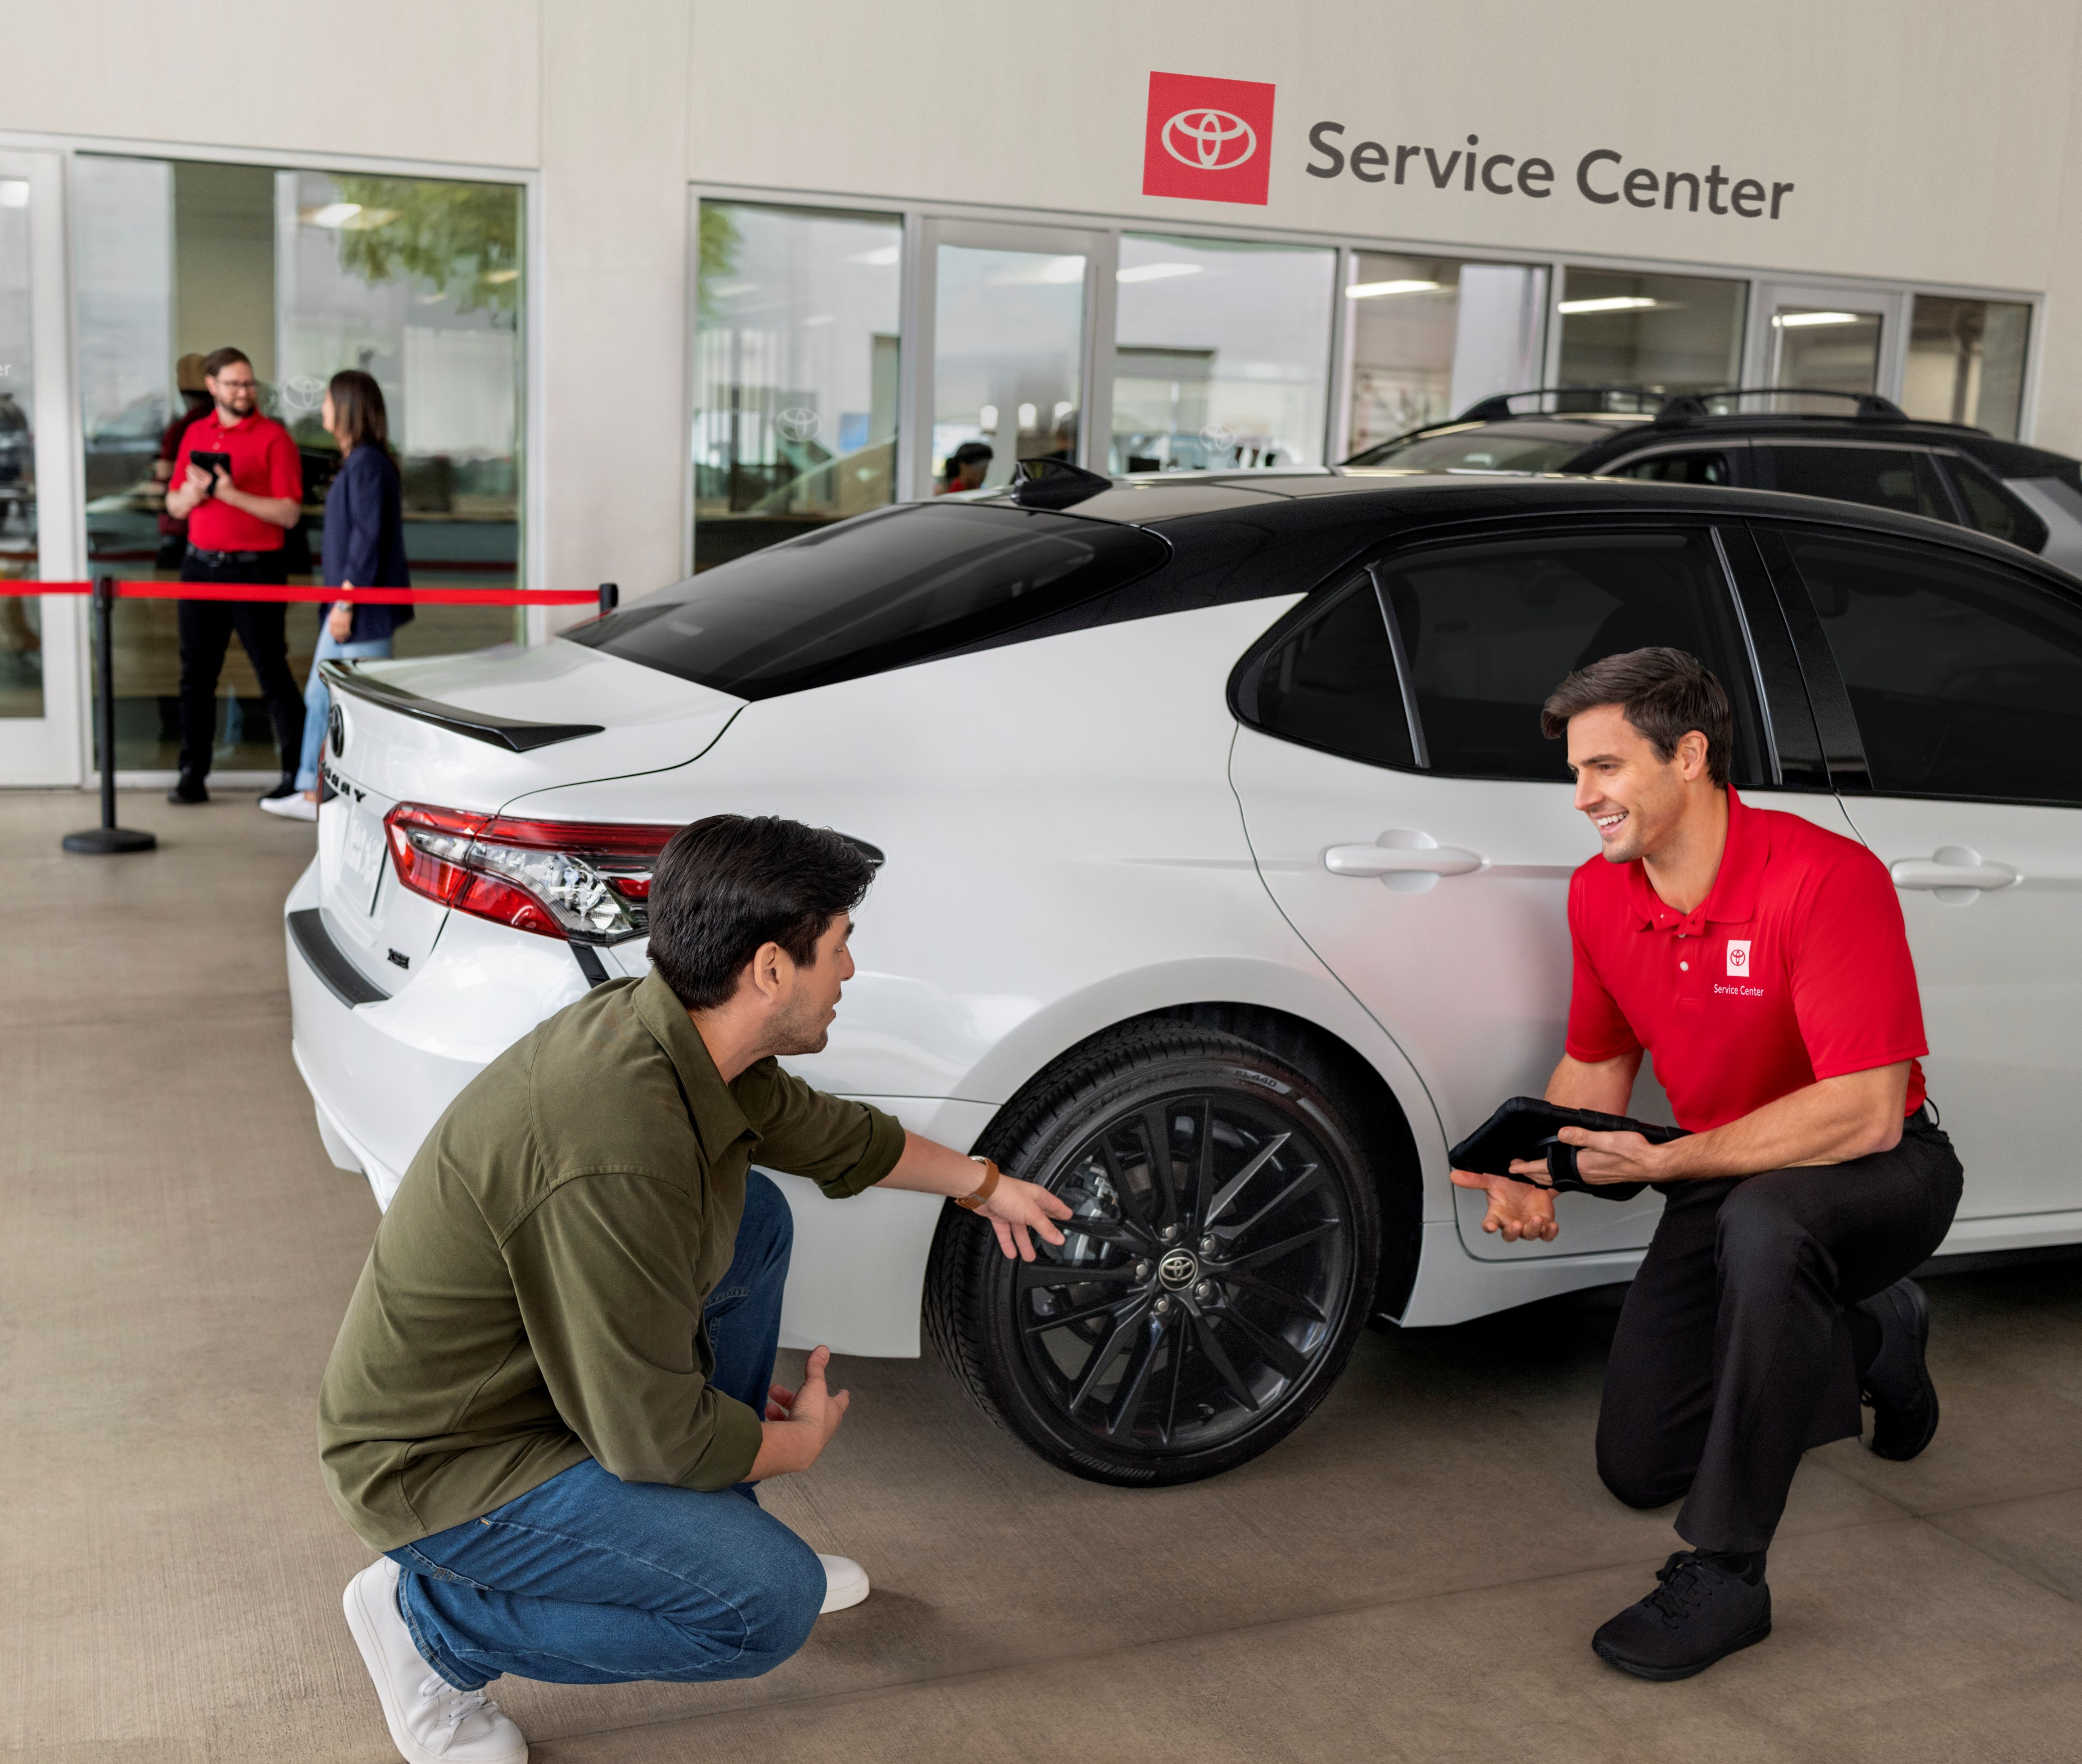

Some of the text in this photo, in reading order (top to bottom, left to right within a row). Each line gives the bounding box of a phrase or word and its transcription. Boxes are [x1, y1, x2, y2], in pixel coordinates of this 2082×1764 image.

[1306, 122, 1794, 219] Service Center
[387, 948, 410, 969] XSE
[1714, 984, 1764, 996] Service Center
